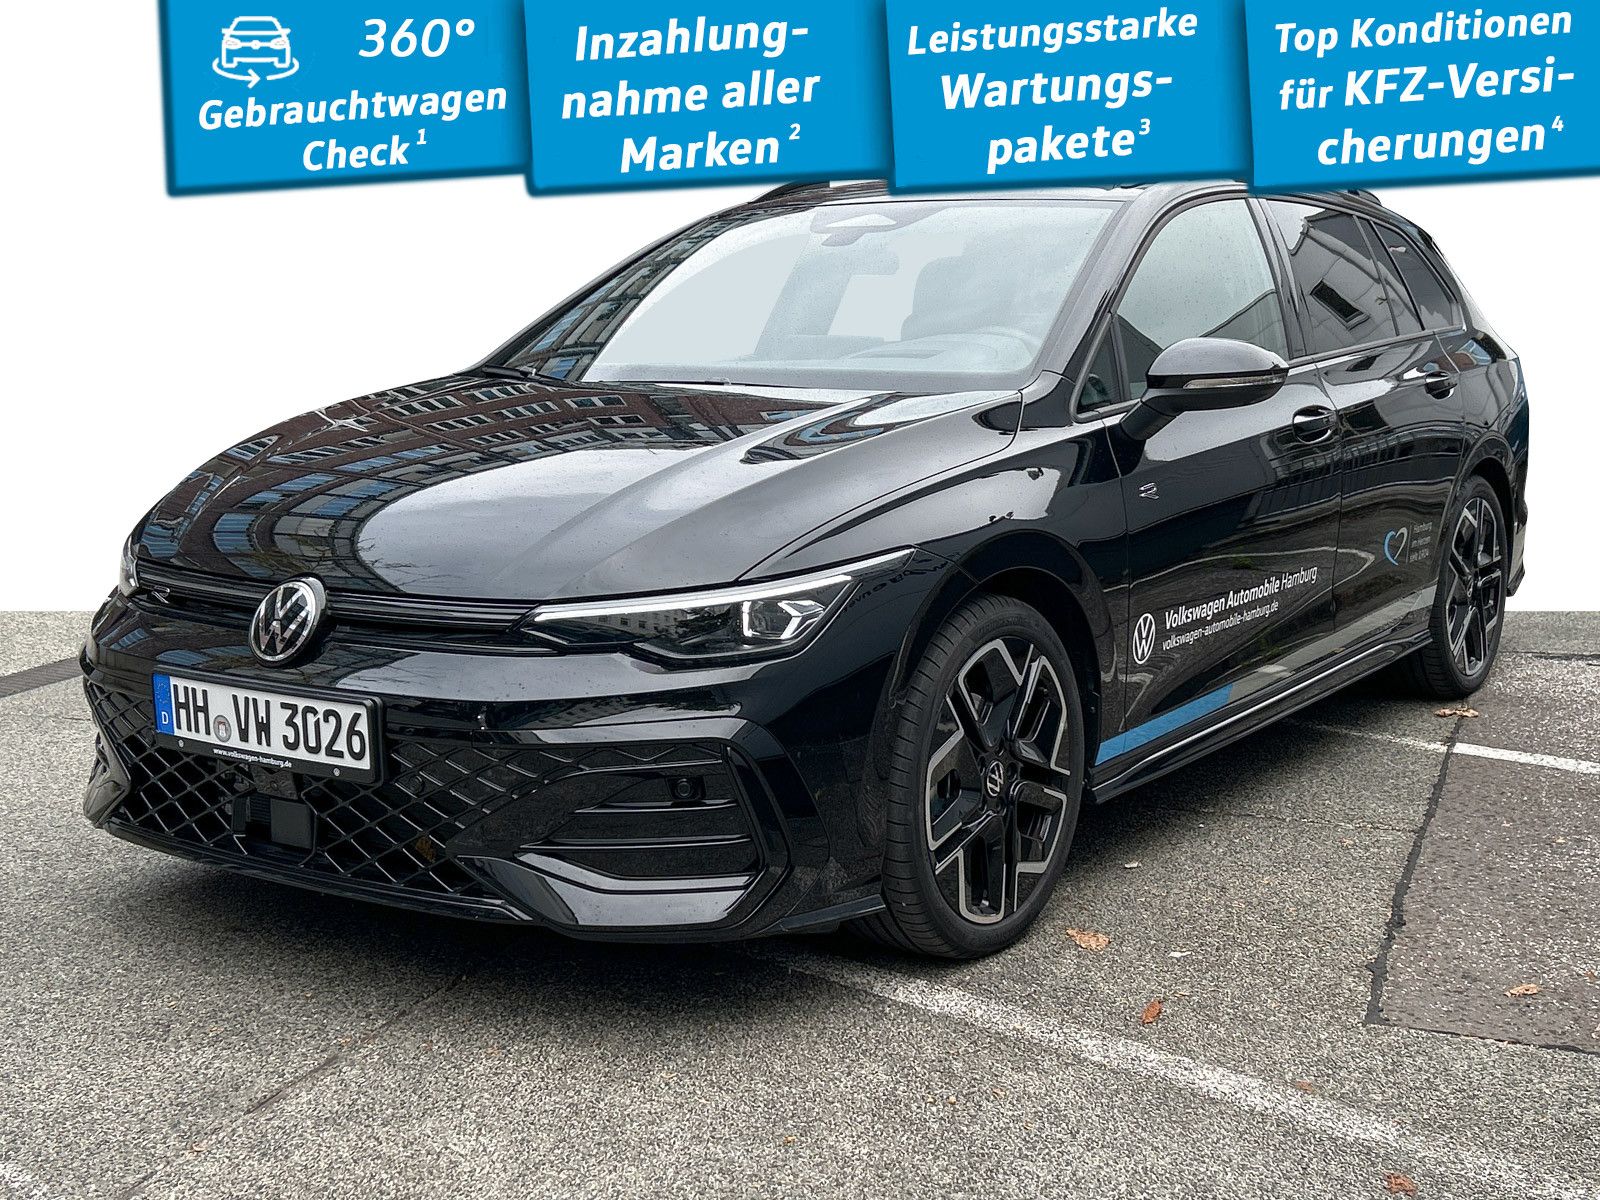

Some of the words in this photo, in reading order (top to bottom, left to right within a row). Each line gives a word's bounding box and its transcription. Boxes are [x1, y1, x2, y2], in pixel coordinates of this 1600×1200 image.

[1162, 599, 1279, 651] volkswagen-automobile-hamburg.de
[1164, 597, 1226, 630] Volkswagen
[1226, 575, 1281, 610] Automobile
[1280, 565, 1318, 591] Hamburg
[161, 710, 170, 725] D
[172, 683, 212, 736] HH
[231, 693, 272, 748] VW
[279, 701, 367, 761] 3026
